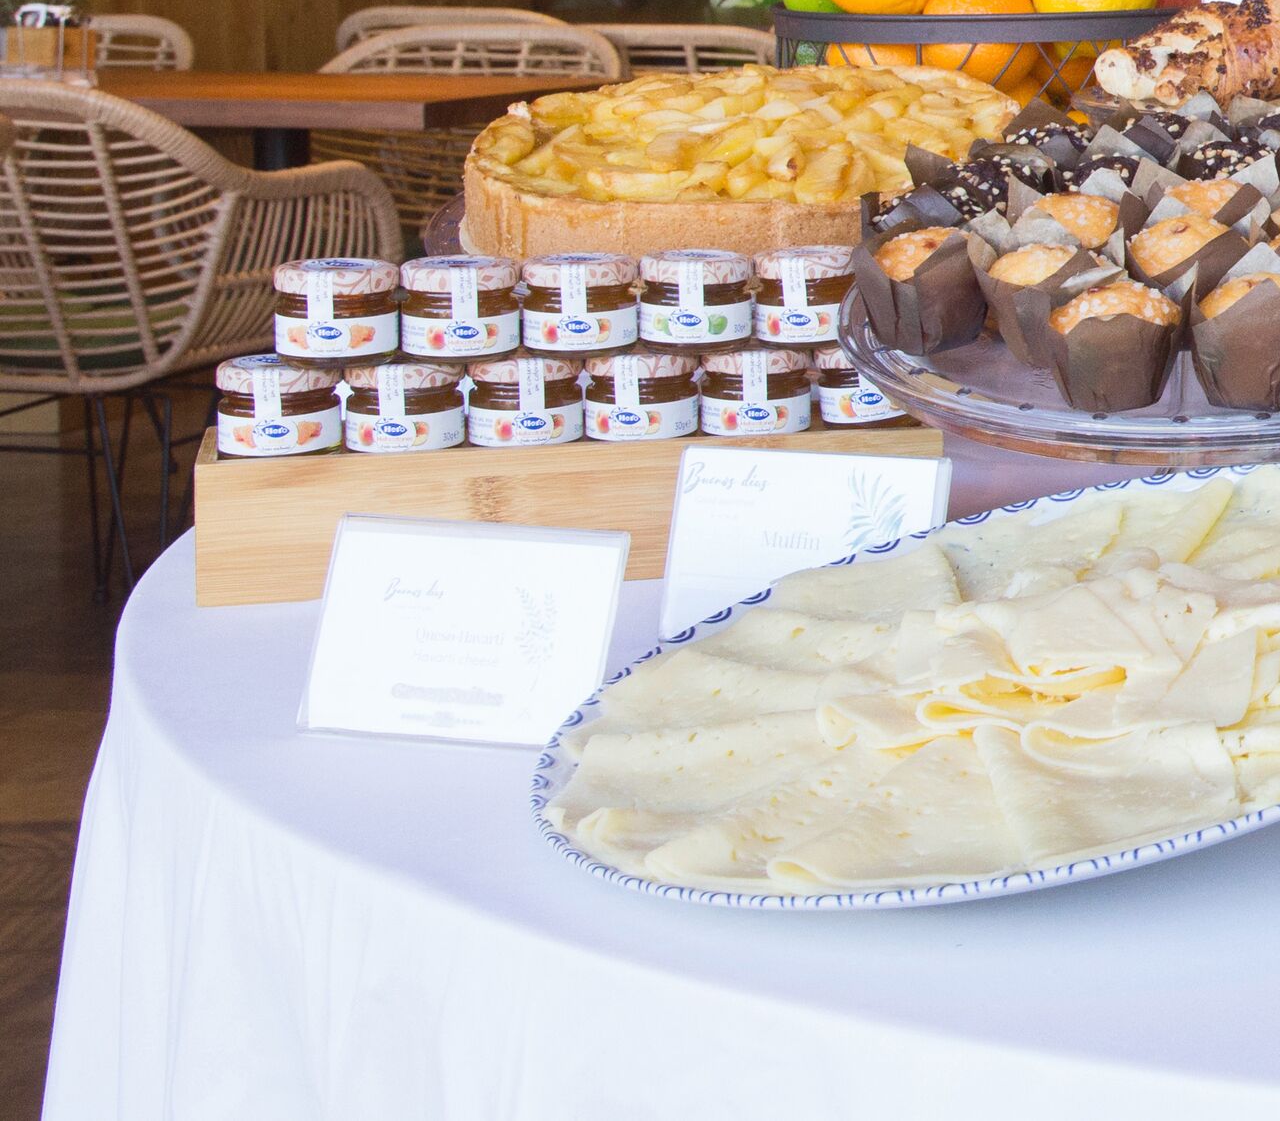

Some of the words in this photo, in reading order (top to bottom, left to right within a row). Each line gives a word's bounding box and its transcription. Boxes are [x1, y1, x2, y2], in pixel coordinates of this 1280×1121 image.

[317, 327, 342, 338] Hero
[455, 327, 478, 338] Hero
[684, 462, 735, 494] Buenos
[760, 529, 821, 551] Muffin
